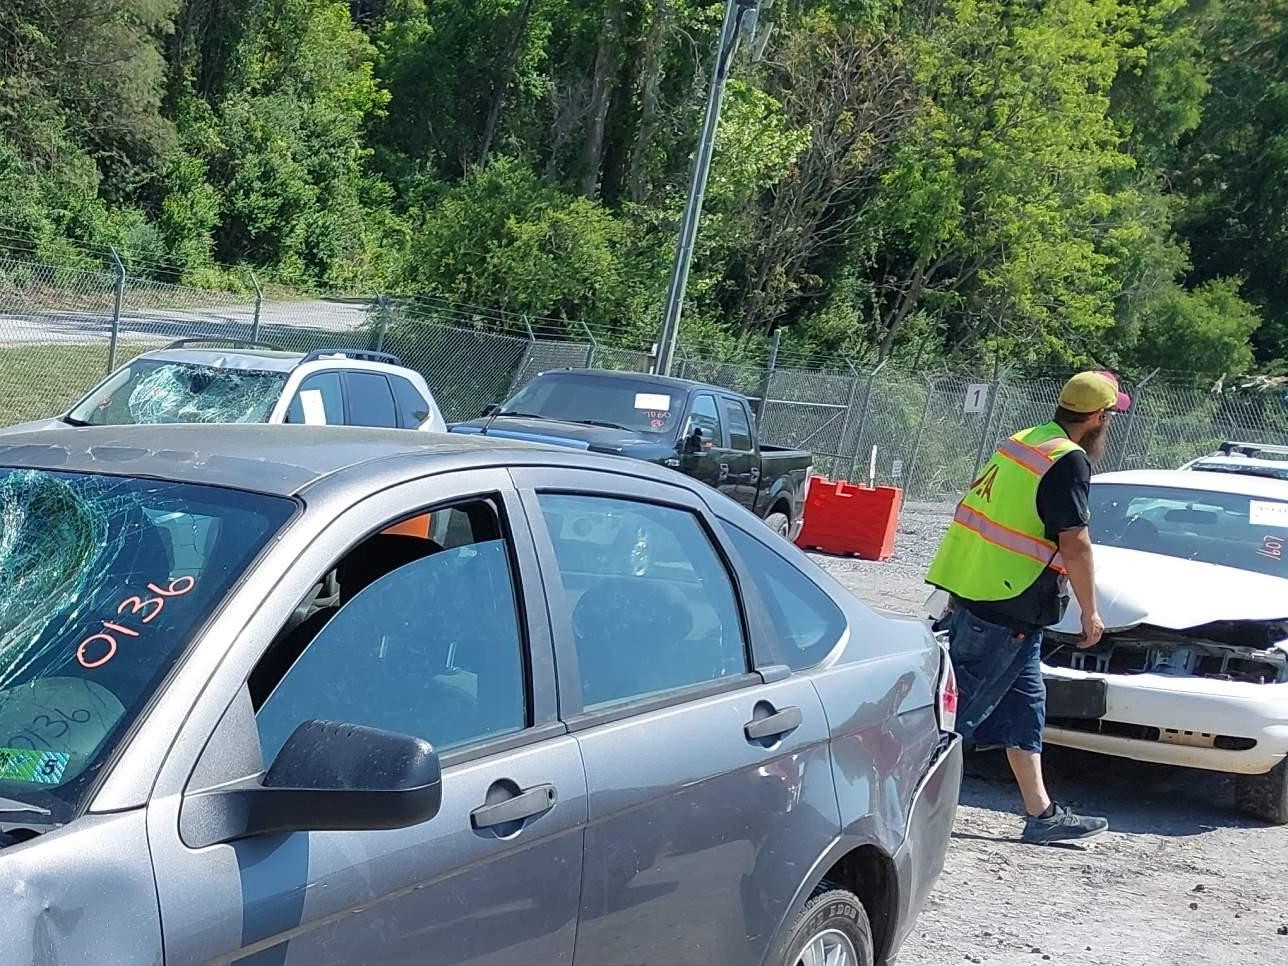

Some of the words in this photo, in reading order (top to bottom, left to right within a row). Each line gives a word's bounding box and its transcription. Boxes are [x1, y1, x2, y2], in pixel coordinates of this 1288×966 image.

[973, 389, 981, 407] 1
[76, 575, 196, 669] 0136
[41, 759, 59, 775] 5
